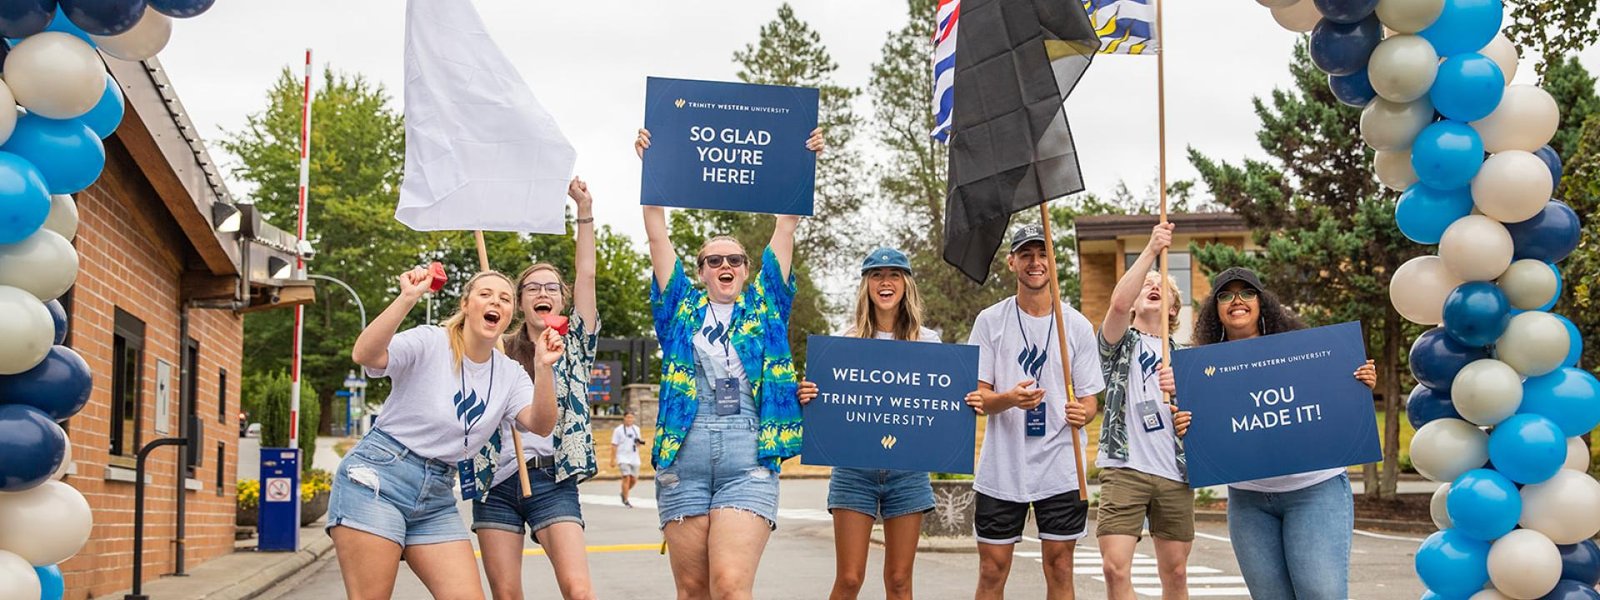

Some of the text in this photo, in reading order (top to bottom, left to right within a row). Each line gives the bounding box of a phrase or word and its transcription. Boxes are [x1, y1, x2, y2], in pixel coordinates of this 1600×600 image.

[751, 106, 790, 114] UNIVERSITY
[689, 126, 771, 146] SO GLAD
[696, 146, 763, 165] YOU'RE
[702, 167, 755, 185] HERE!
[1219, 350, 1332, 373] TRINITY WESTERN UNIVERSITY
[832, 367, 952, 388] WELCOME TO
[821, 392, 960, 411] TRINITY WESTERN
[1249, 386, 1295, 408] YOU
[846, 411, 935, 427] UNIVERSITY
[1231, 404, 1322, 433] MADE IT!
